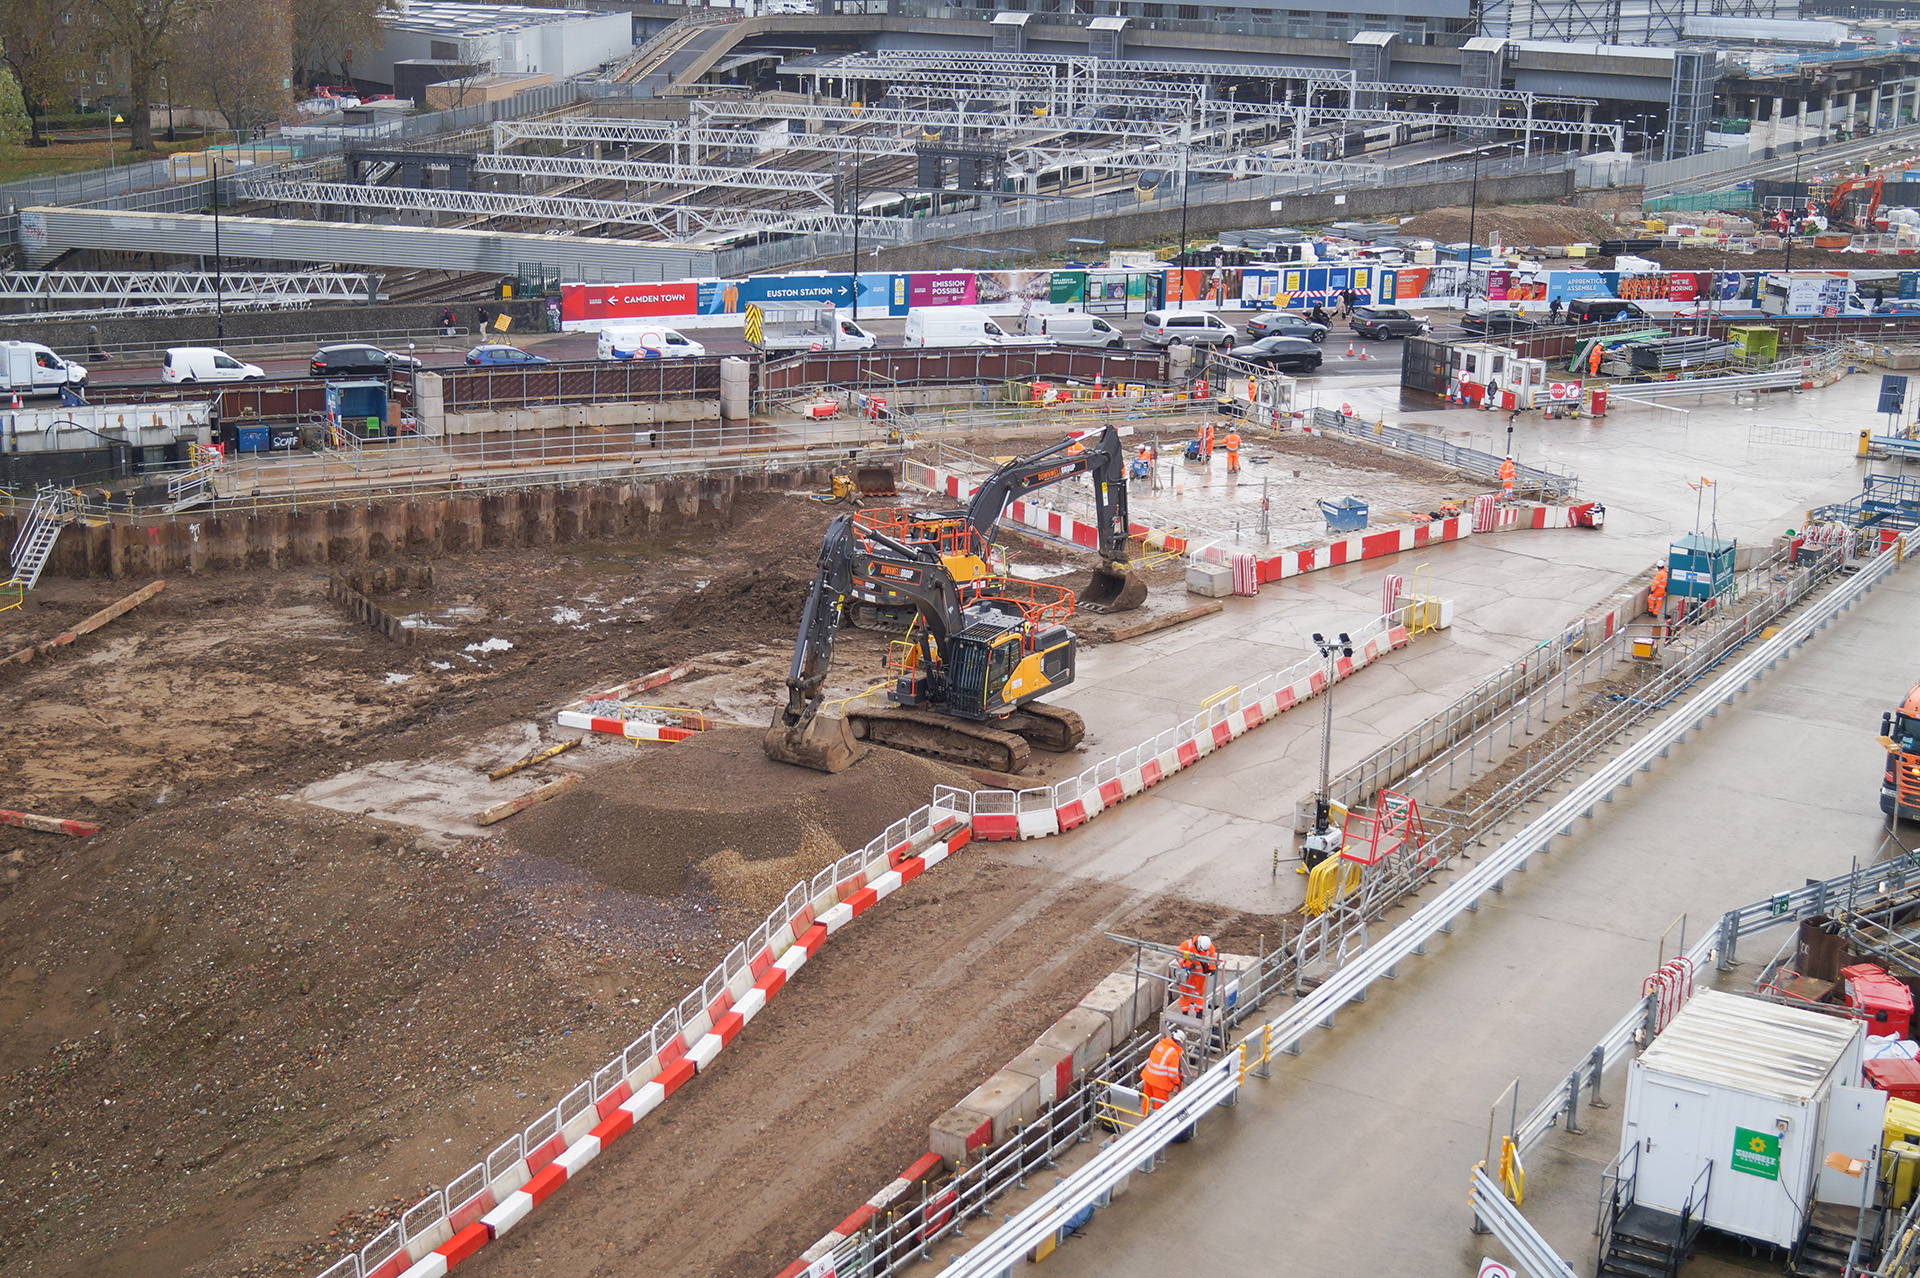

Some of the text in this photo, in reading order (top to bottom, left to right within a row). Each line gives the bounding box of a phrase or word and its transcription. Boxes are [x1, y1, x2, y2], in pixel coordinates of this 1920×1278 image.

[932, 280, 965, 288] EMISSION
[1567, 277, 1607, 286] APPRENTICES
[767, 287, 833, 298] EUSTON STATION
[931, 287, 965, 295] POSSIBLE
[1670, 284, 1693, 292] BORING
[624, 292, 685, 304] CAMDEN TOWN
[273, 436, 298, 447] SCAFF
[1735, 1149, 1776, 1166] SUNBELT
[1740, 1156, 1770, 1167] RENTALS
